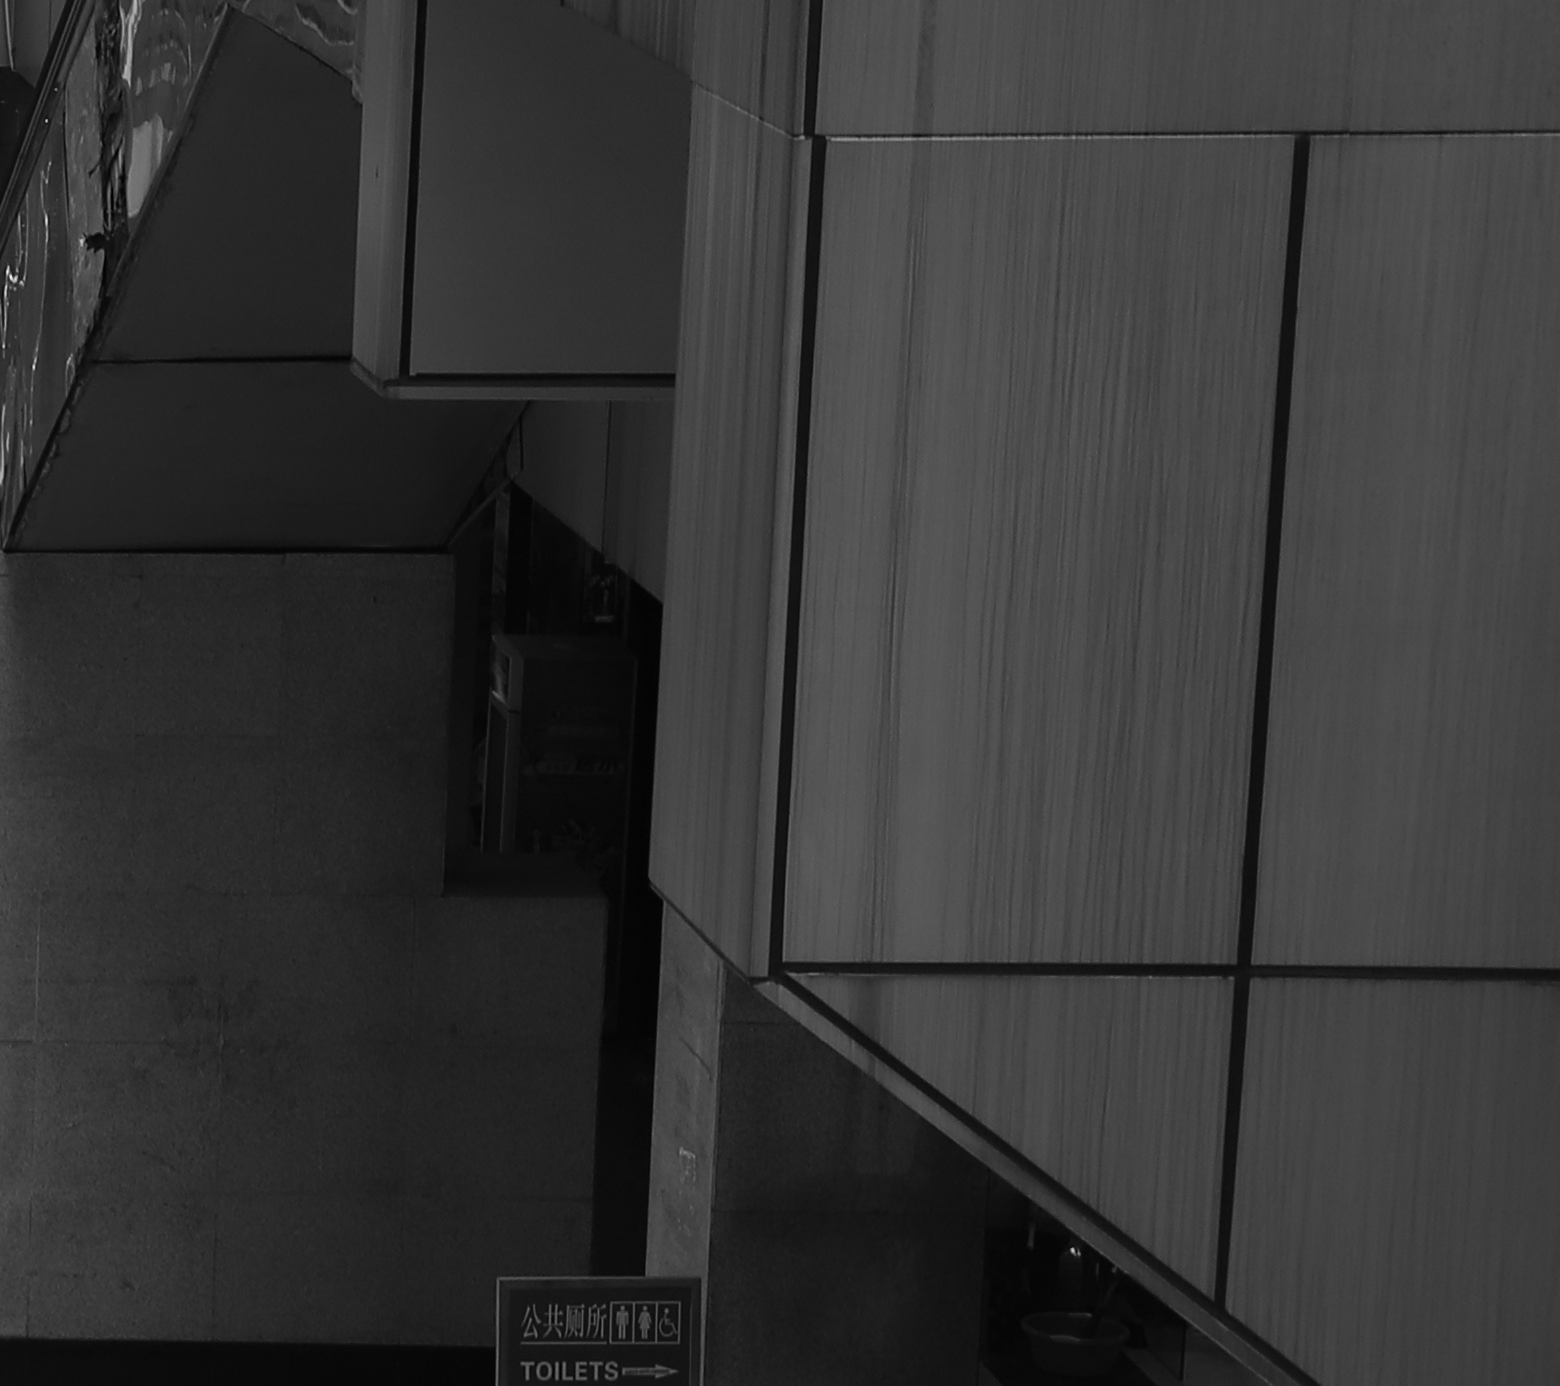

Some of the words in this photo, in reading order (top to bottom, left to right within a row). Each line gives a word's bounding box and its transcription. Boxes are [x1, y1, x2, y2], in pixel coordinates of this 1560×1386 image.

[520, 1302, 608, 1342] 公共厕所
[520, 1360, 620, 1383] TOILETS
